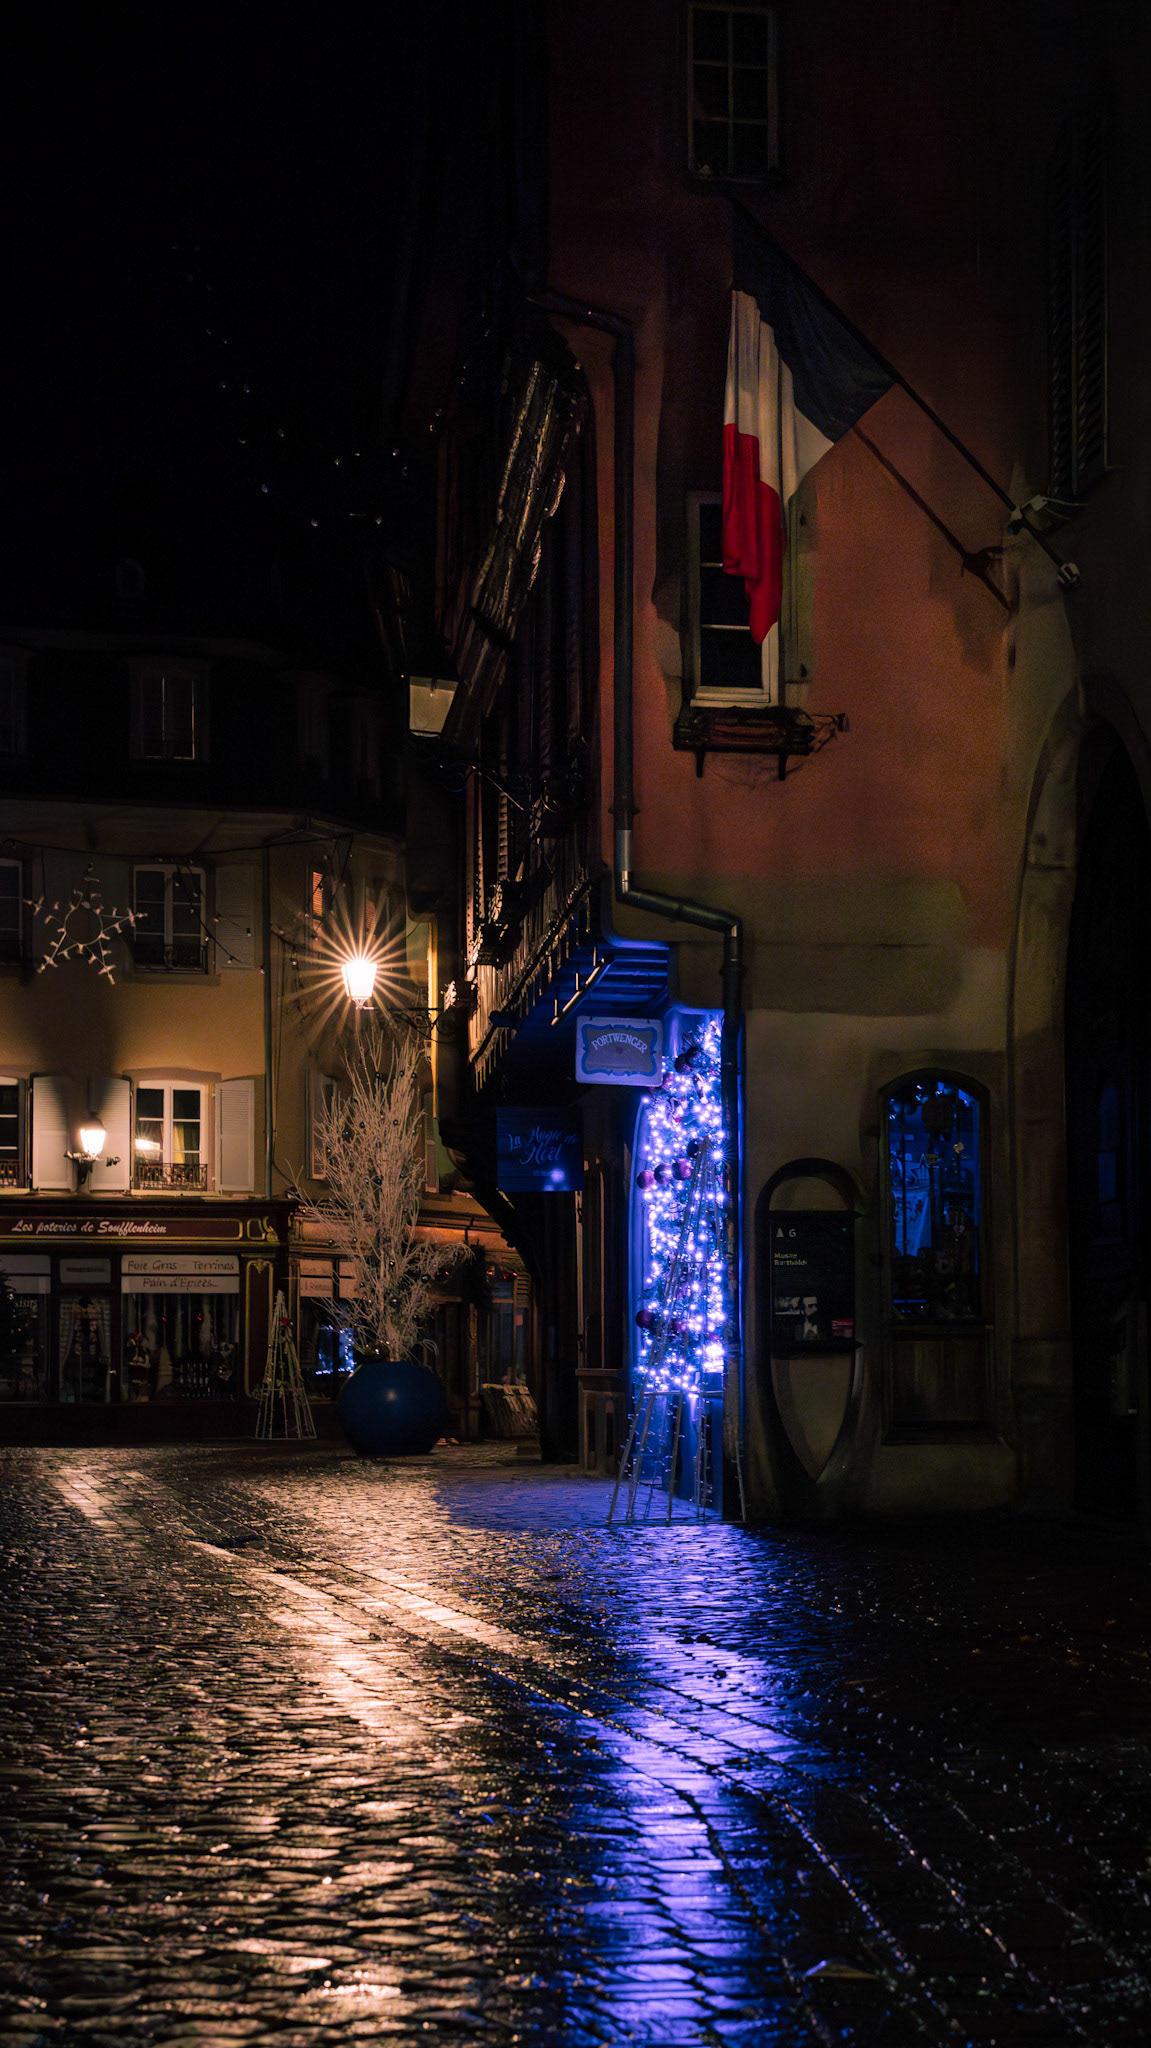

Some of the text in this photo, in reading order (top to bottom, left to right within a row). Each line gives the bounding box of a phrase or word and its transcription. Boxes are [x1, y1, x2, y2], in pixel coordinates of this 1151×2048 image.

[591, 1032, 648, 1054] FORTWENGER
[11, 1219, 167, 1236] Les poteries de Soufflenheim
[128, 1260, 148, 1270] Foie
[152, 1260, 177, 1270] Gras
[193, 1259, 235, 1271] Terrines
[143, 1278, 167, 1288] Pain
